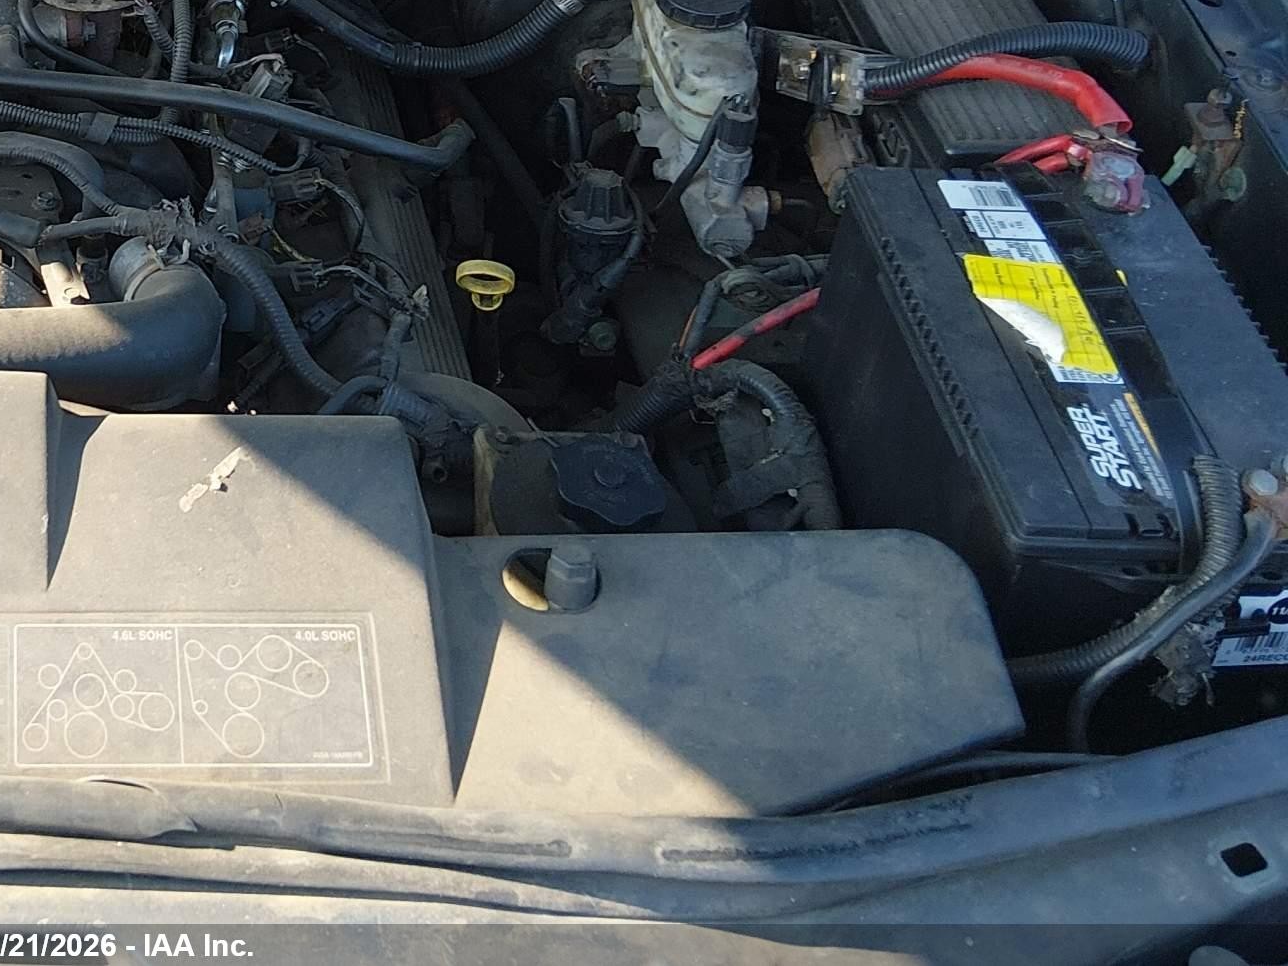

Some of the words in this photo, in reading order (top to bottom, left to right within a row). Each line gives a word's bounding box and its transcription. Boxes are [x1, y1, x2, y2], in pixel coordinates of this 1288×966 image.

[1066, 405, 1112, 479] SUPER
[1083, 405, 1144, 490] START
[112, 630, 137, 641] 4.6L
[139, 630, 173, 641] SOHC
[295, 630, 319, 641] 4.0L
[321, 630, 356, 641] SOHC
